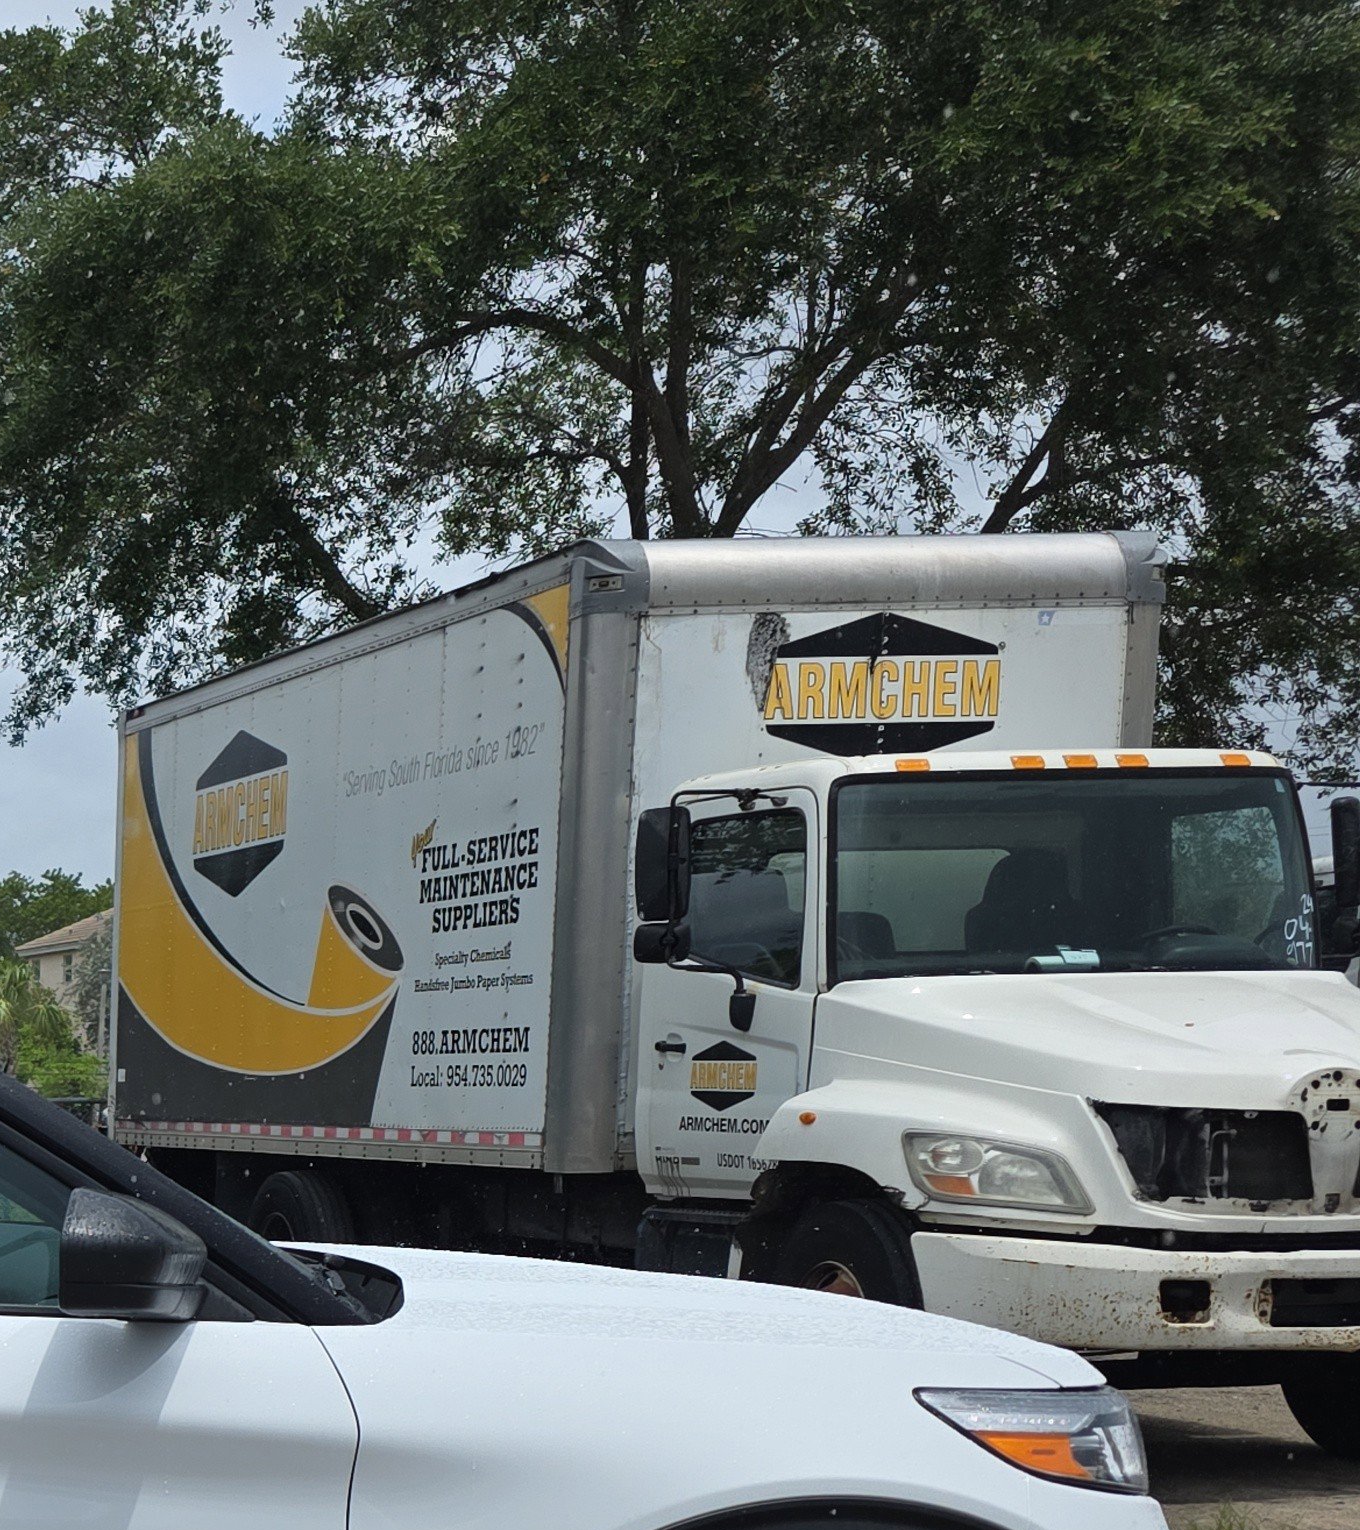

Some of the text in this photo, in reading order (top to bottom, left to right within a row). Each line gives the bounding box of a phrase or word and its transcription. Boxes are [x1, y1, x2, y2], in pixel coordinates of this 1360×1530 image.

[763, 660, 1001, 719] ARMCHEM
[388, 758, 421, 788] South
[423, 746, 463, 781] Florida
[466, 738, 500, 770] since
[192, 770, 289, 855] ARMCHEM
[421, 827, 540, 873] FULL-SERVICE
[419, 861, 539, 904] MAINTENANCE
[431, 897, 520, 934] SUPPLIERS
[434, 944, 512, 970] Specialty Chemicals
[449, 975, 476, 994] Jumbo
[476, 974, 500, 992] Paper
[500, 972, 534, 993] Systems
[412, 1027, 530, 1055] 888.ARMCHEM
[410, 1063, 528, 1088] Local: 954.735.0029
[689, 1062, 758, 1091] ARMCHEM
[678, 1115, 770, 1135] ARMCHEM.COM
[716, 1153, 745, 1169] USDOT
